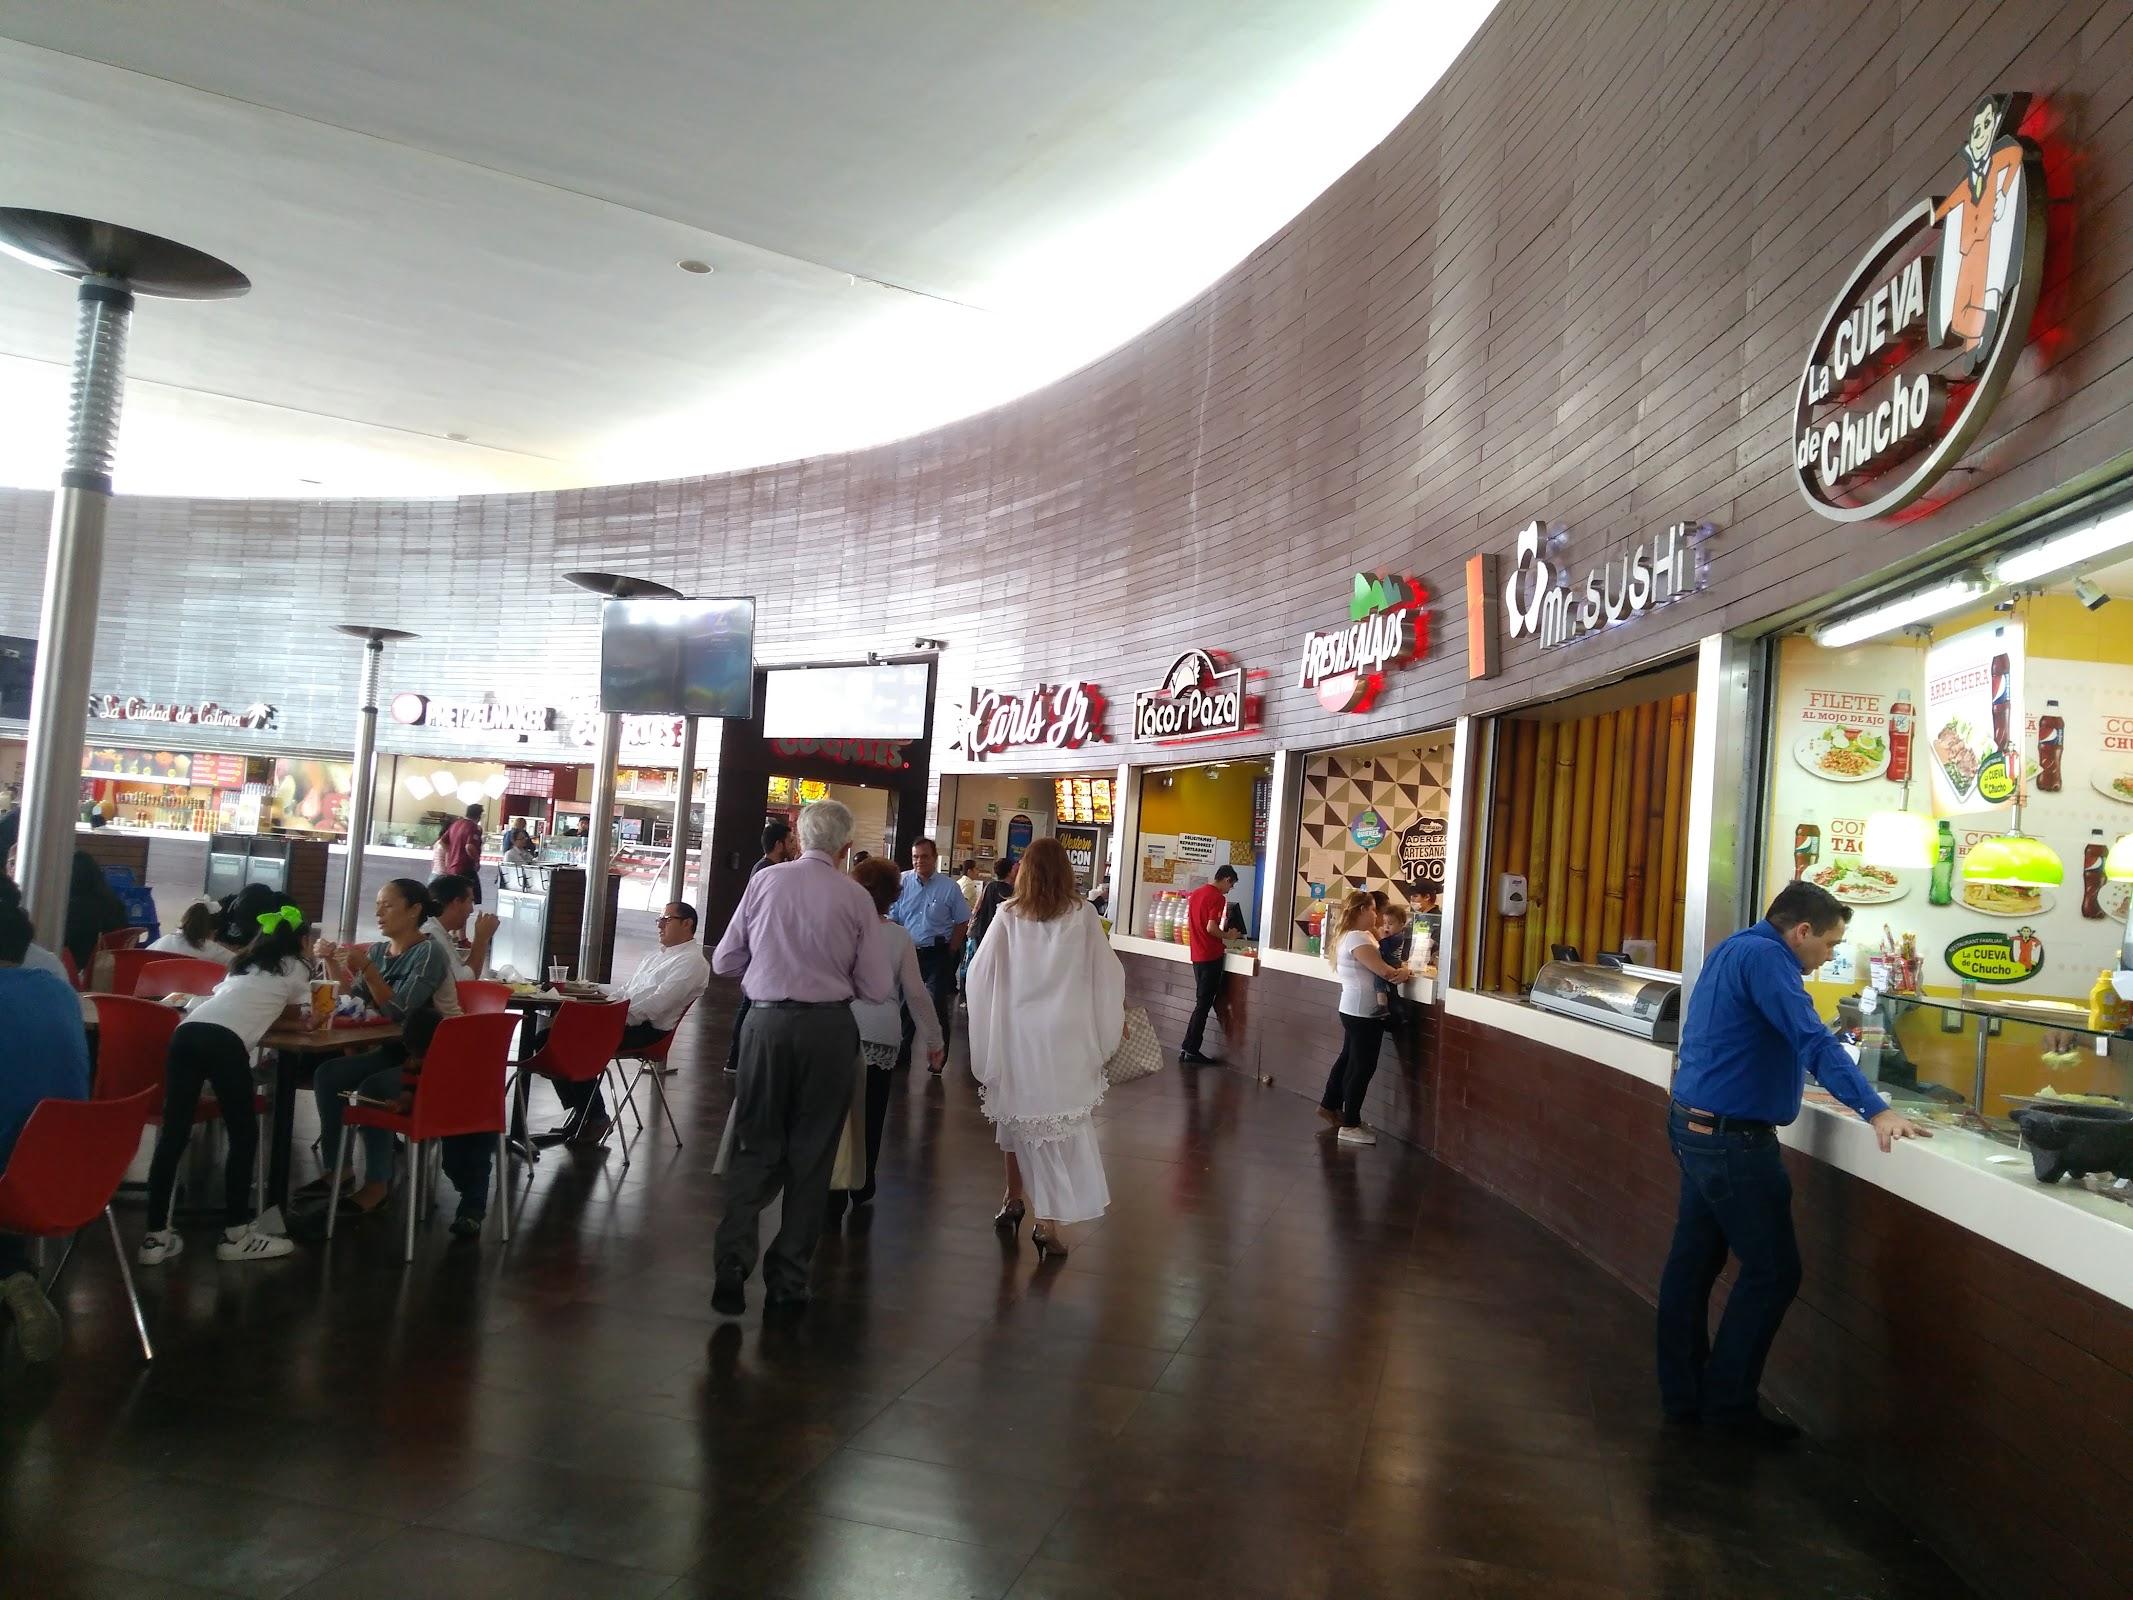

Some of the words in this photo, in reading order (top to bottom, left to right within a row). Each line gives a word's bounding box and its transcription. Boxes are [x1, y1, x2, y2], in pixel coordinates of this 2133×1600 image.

[1808, 364, 1830, 405] La
[1834, 256, 1925, 381] CUEVA
[1798, 427, 1821, 469] de
[1820, 373, 1930, 487] Chucho
[1930, 669, 1990, 701] ARRACHERA
[100, 695, 119, 719] La
[125, 697, 171, 722] Ciudad
[175, 706, 191, 723] de
[197, 701, 241, 728] Colima
[1137, 696, 1186, 735] Tacos
[1187, 688, 1237, 730] Paza
[1809, 692, 1880, 712] FILETE
[970, 683, 1047, 753] Carl's
[1046, 680, 1093, 748] Jr.
[1802, 711, 1816, 719] AL
[1818, 712, 1847, 723] MOJO
[1866, 717, 1885, 725] AJO
[1060, 833, 1092, 850] Western
[1406, 836, 1448, 844] ADEREZ
[1973, 949, 2007, 960] CUEVA
[1971, 963, 2011, 975] Chucho
